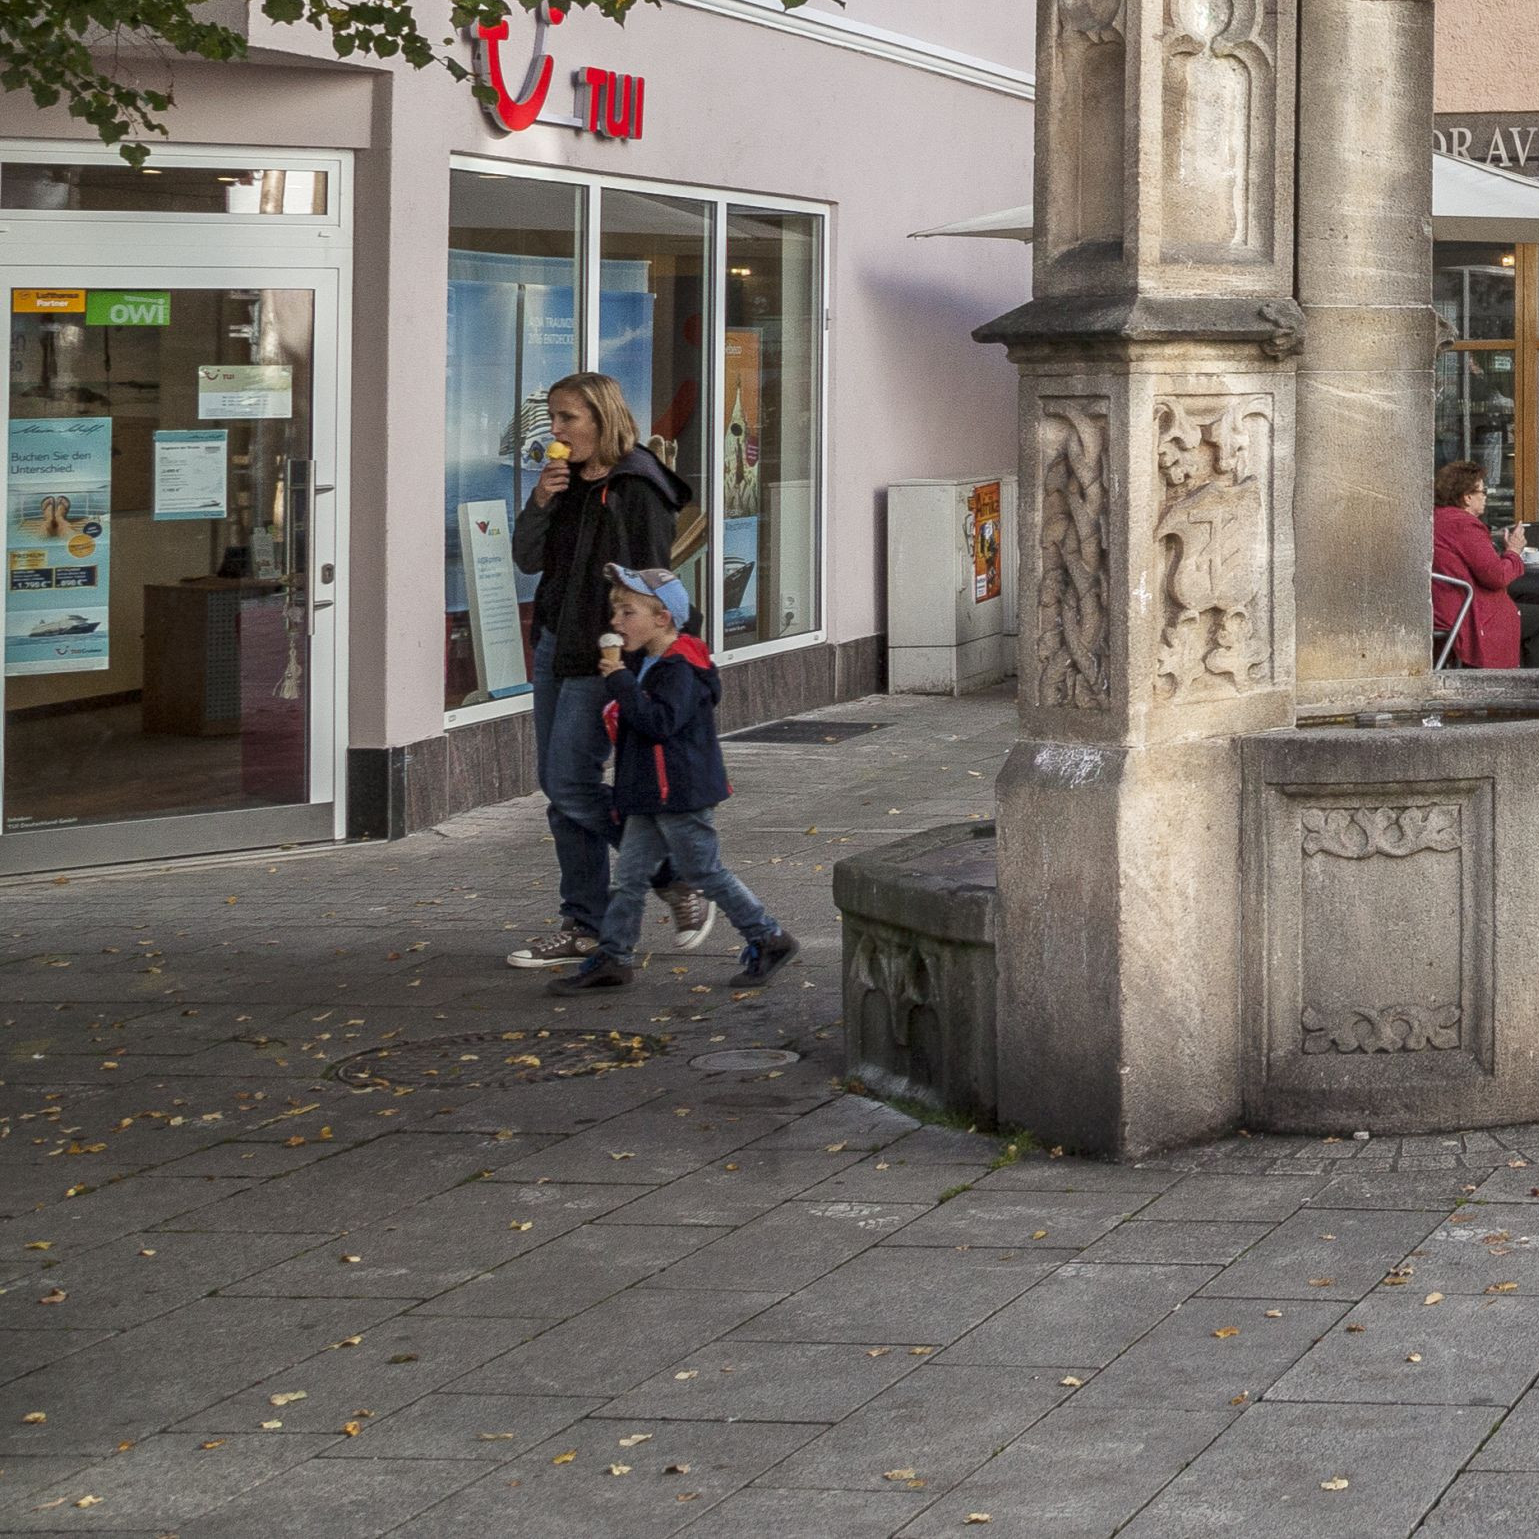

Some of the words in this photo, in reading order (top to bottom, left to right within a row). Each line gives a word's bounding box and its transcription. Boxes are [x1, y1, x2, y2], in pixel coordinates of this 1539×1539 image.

[586, 67, 645, 140] TUI
[11, 452, 49, 462] Buchen
[53, 451, 69, 461] Sie
[71, 450, 91, 460] den
[11, 464, 75, 475] Unterschied.
